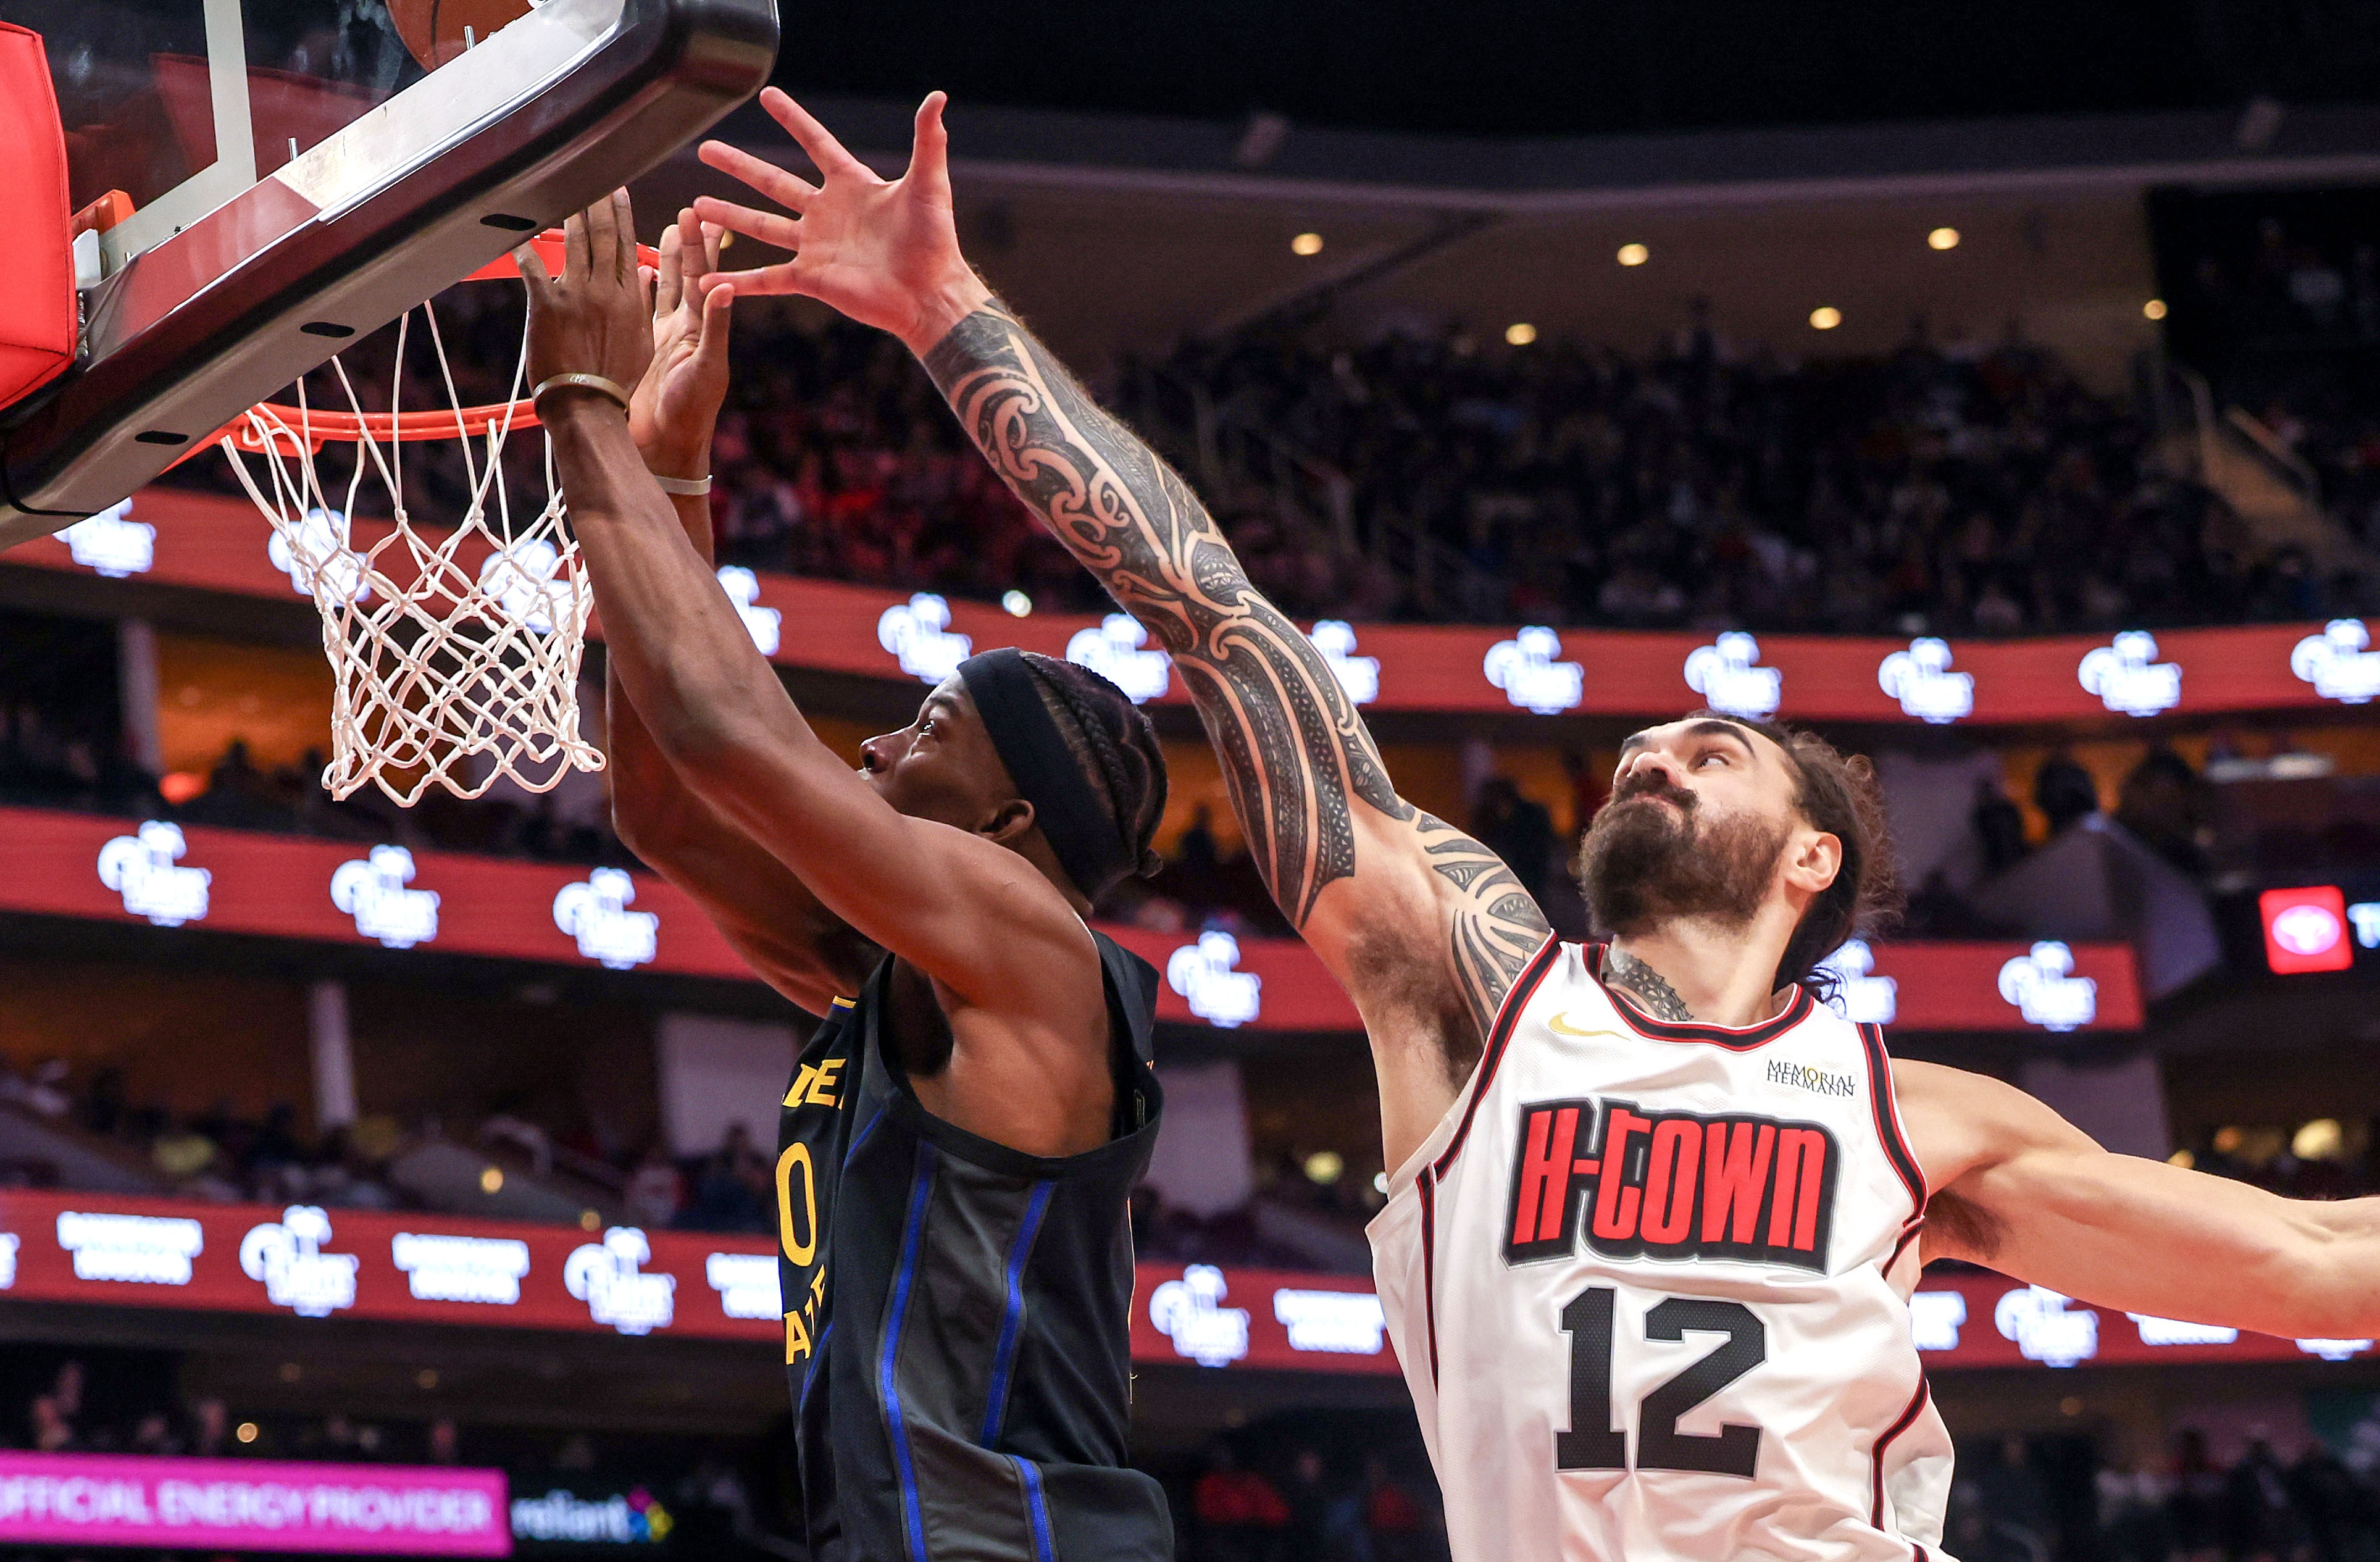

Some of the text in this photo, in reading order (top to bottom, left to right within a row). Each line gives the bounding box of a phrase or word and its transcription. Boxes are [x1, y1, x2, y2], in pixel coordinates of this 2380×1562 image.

[1767, 1058, 1856, 1087] MEMORIAL
[1767, 1069, 1854, 1097] HERMANN
[1555, 1285, 1768, 1481] 12
